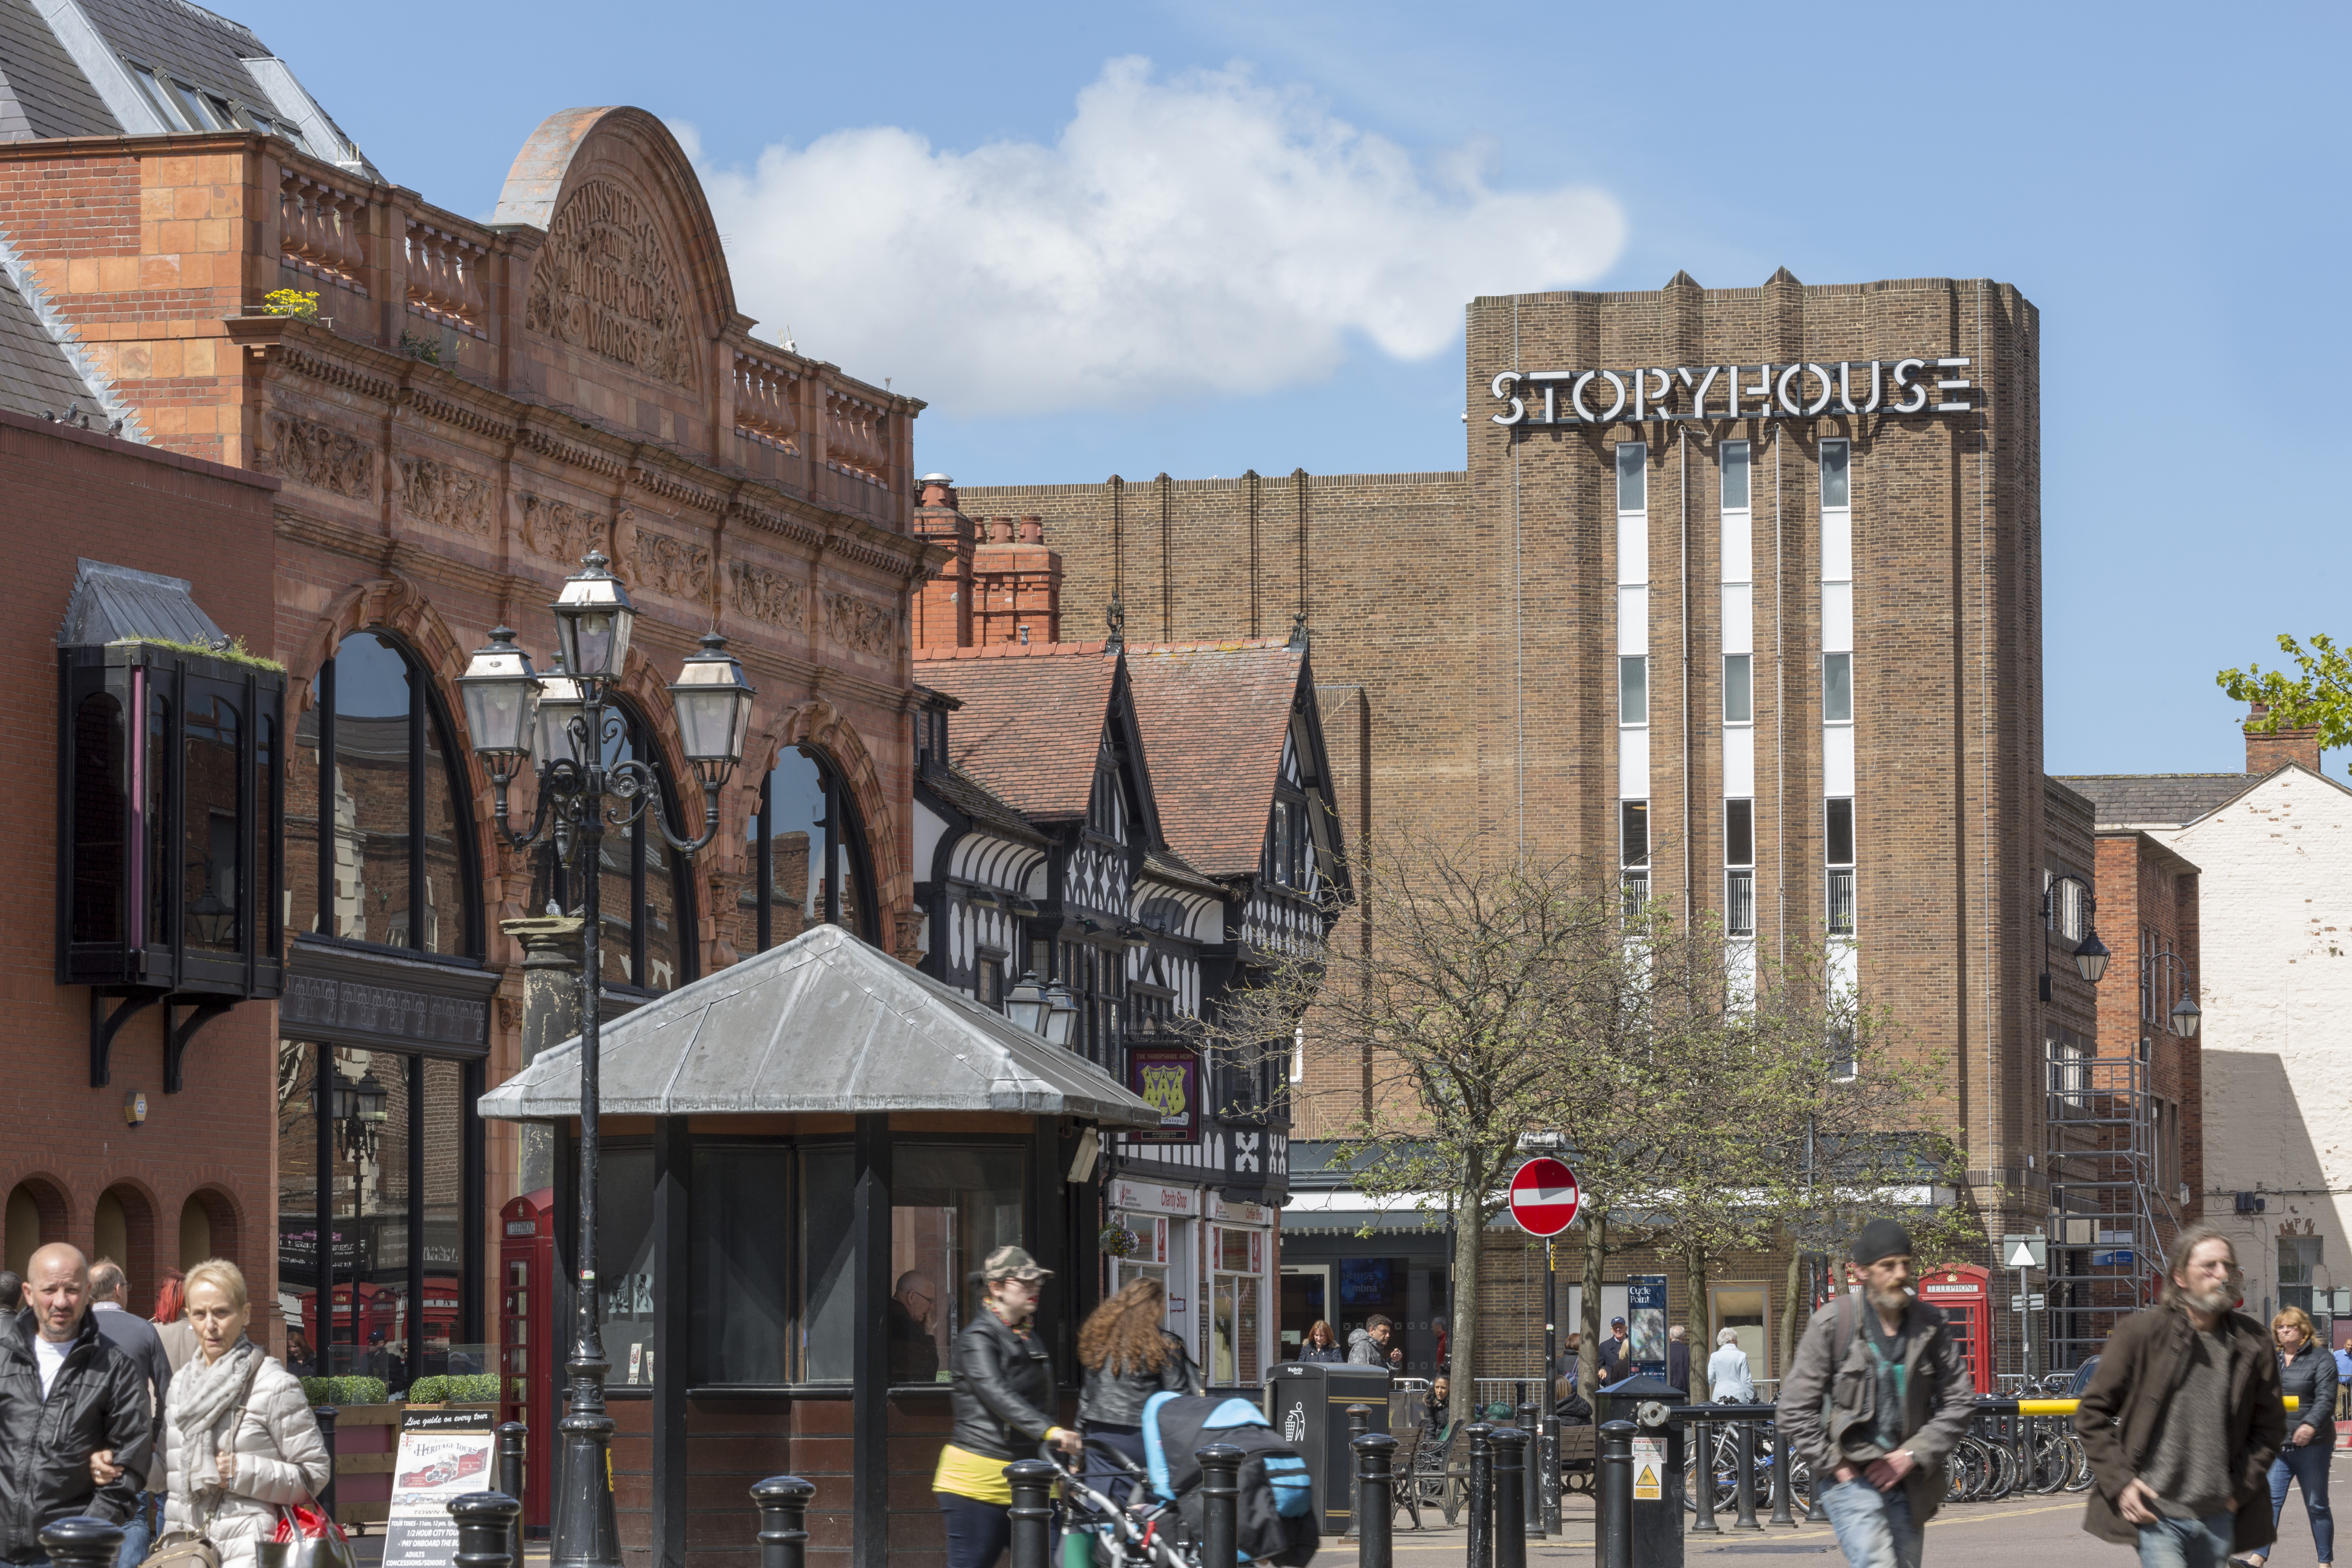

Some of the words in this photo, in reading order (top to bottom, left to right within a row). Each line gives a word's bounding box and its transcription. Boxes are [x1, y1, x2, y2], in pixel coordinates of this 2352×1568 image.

[534, 180, 639, 293] WESTMINSTER
[602, 230, 624, 263] AND
[569, 250, 620, 312] MOTOR
[626, 274, 656, 324] CAR
[584, 303, 638, 364] WORKS
[1491, 358, 1971, 425] STORYHOUSE
[1161, 1189, 1176, 1211] Charity
[1176, 1191, 1187, 1213] Shop
[1246, 1208, 1255, 1220] Coffee
[508, 1222, 535, 1234] TELEPHONE
[1352, 1283, 1377, 1292] mbna
[1630, 1287, 1651, 1296] Cycle
[405, 1417, 421, 1426] Live
[422, 1415, 442, 1427] guide
[454, 1415, 472, 1423] every
[413, 1443, 454, 1456] HERITAGE
[456, 1443, 478, 1454] TOURS
